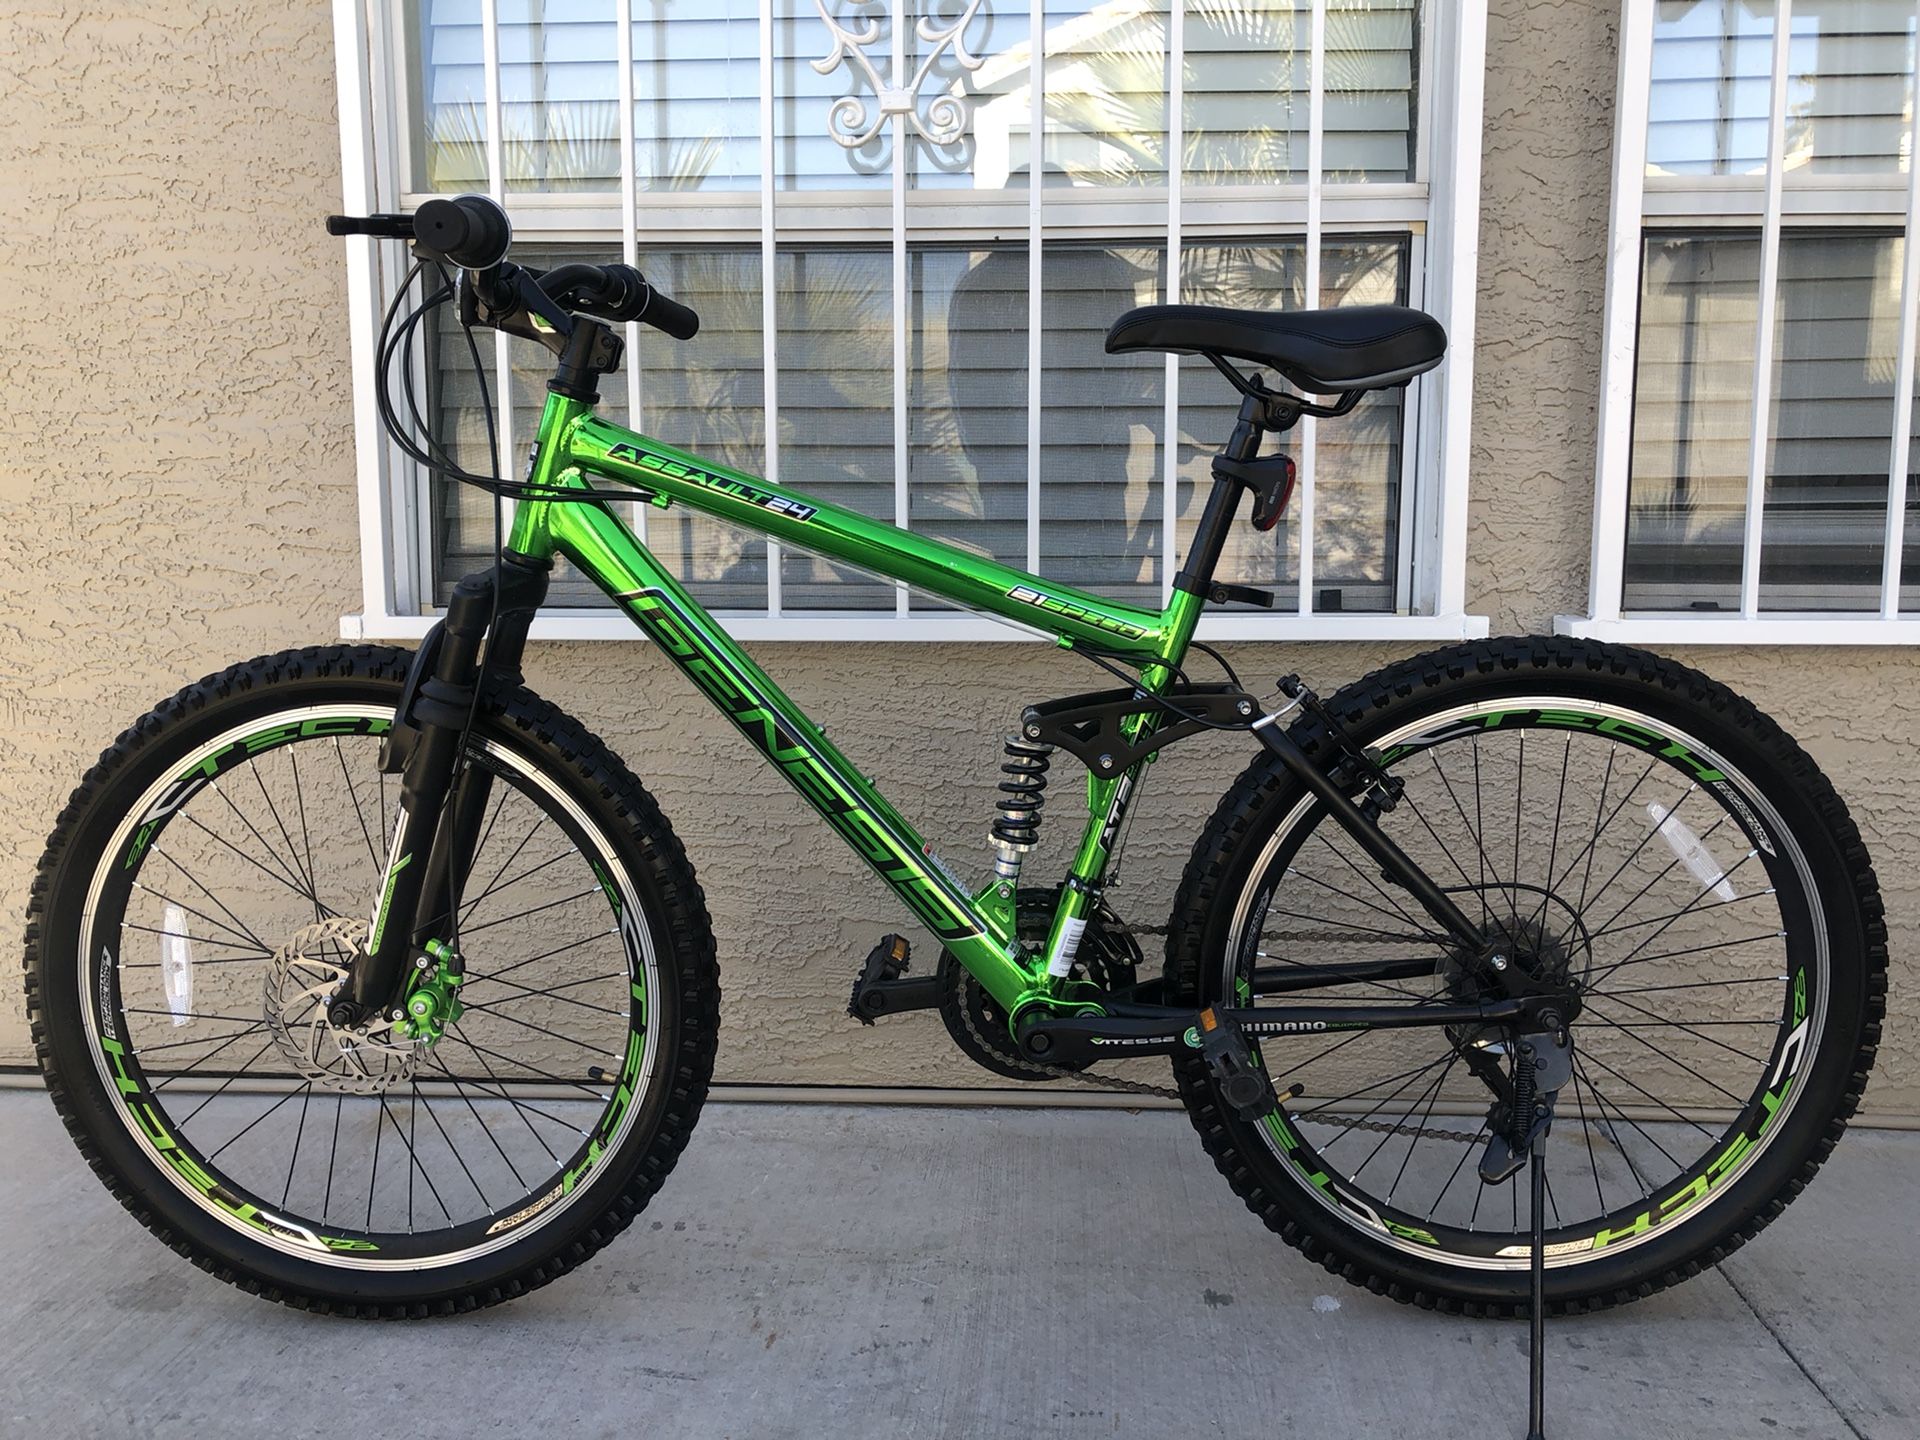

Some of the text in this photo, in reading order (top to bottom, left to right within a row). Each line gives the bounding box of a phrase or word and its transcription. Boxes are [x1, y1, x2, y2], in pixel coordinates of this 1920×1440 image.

[613, 446, 811, 519] ASSAULT 24
[1043, 598, 1146, 638] SPEED
[626, 595, 974, 932] GENESIS
[1089, 1036, 1176, 1045] VITESSE
[1241, 1021, 1327, 1032] HIMANO
